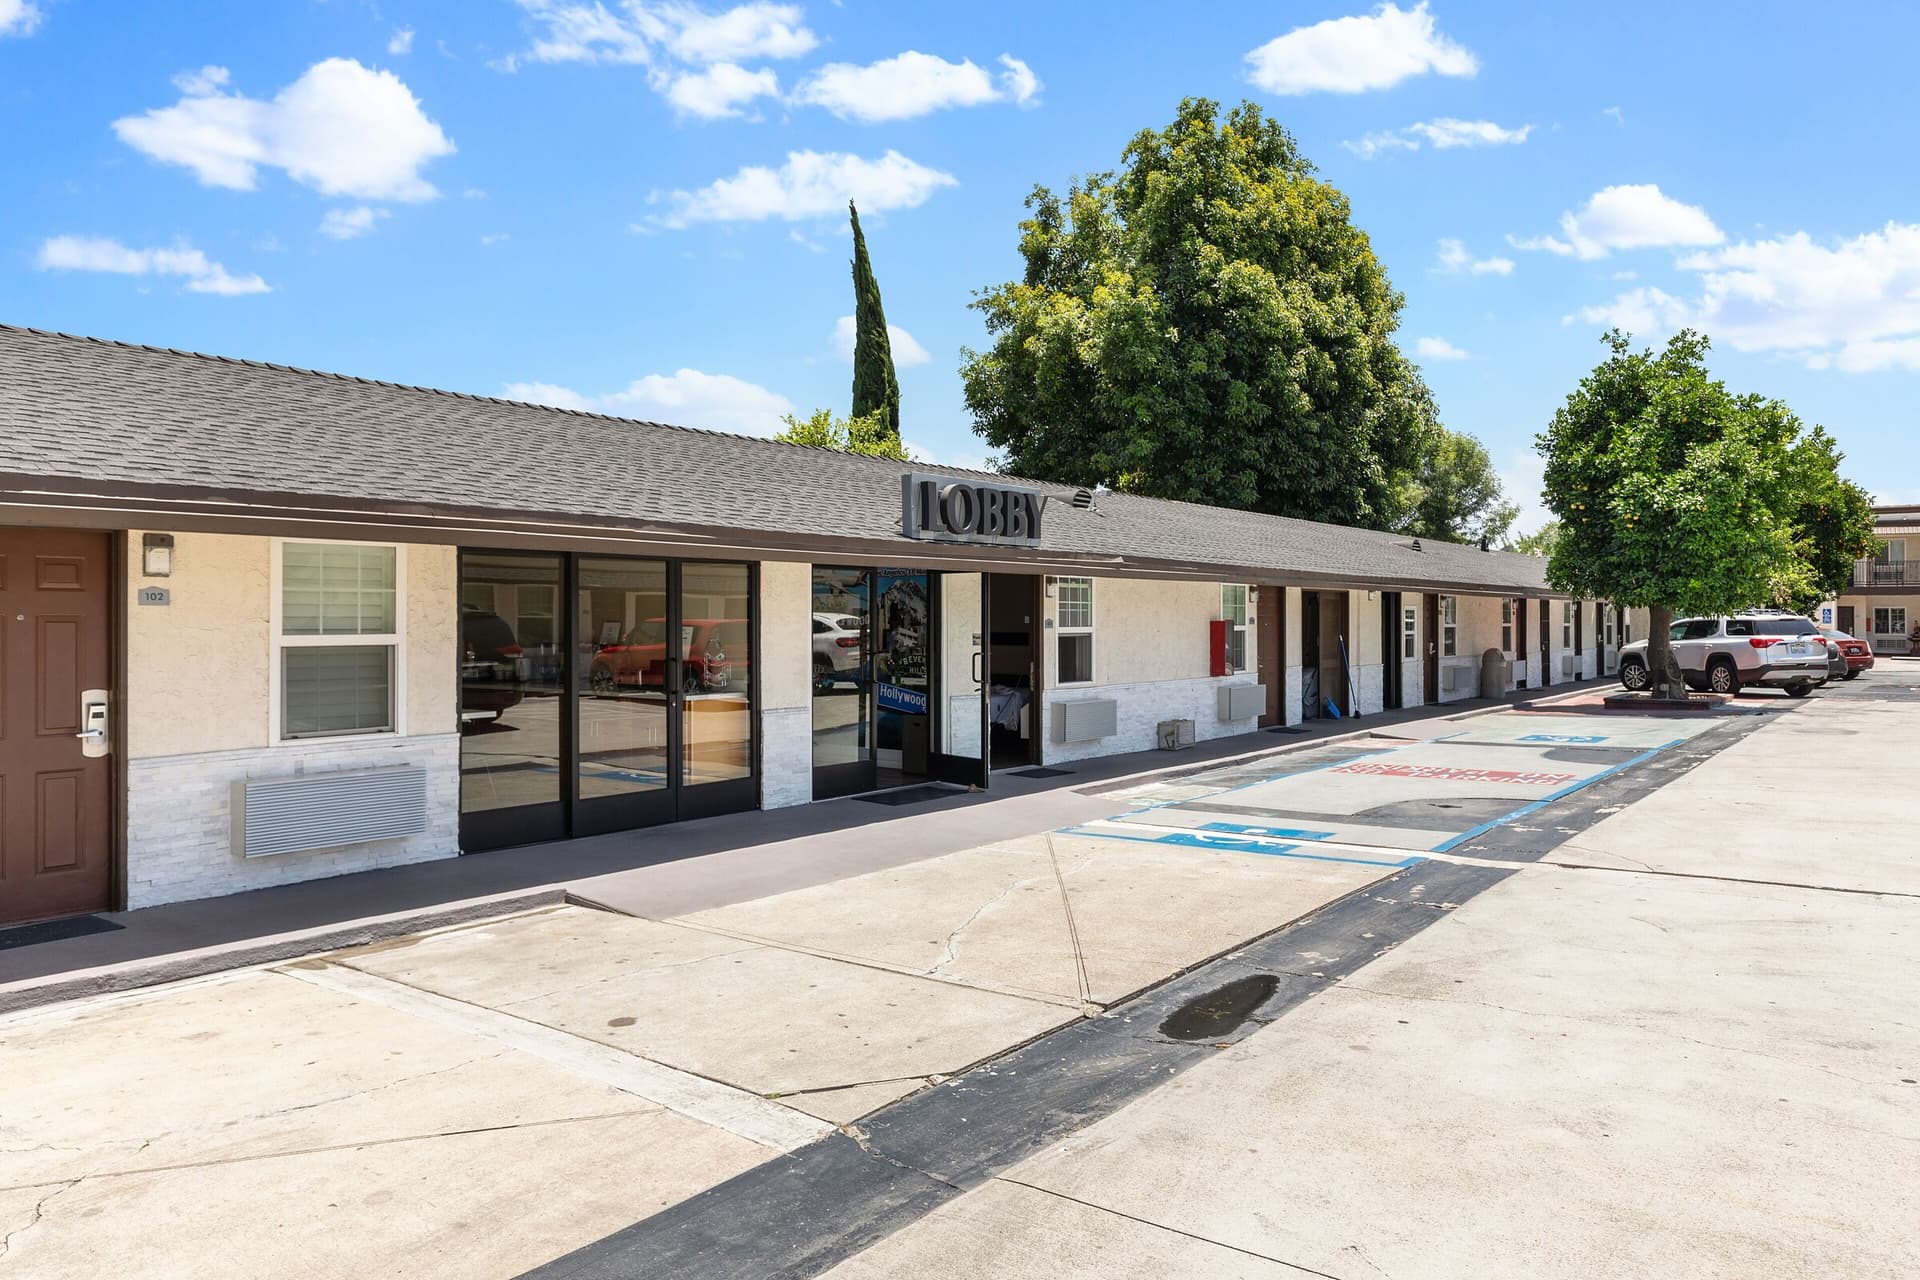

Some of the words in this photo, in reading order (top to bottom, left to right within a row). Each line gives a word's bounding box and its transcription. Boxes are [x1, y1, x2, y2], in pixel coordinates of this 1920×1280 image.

[920, 481, 1048, 539] LOBBY
[144, 592, 164, 601] 102
[880, 684, 927, 707] Hollywood
[1407, 772, 1561, 785] PARKING
